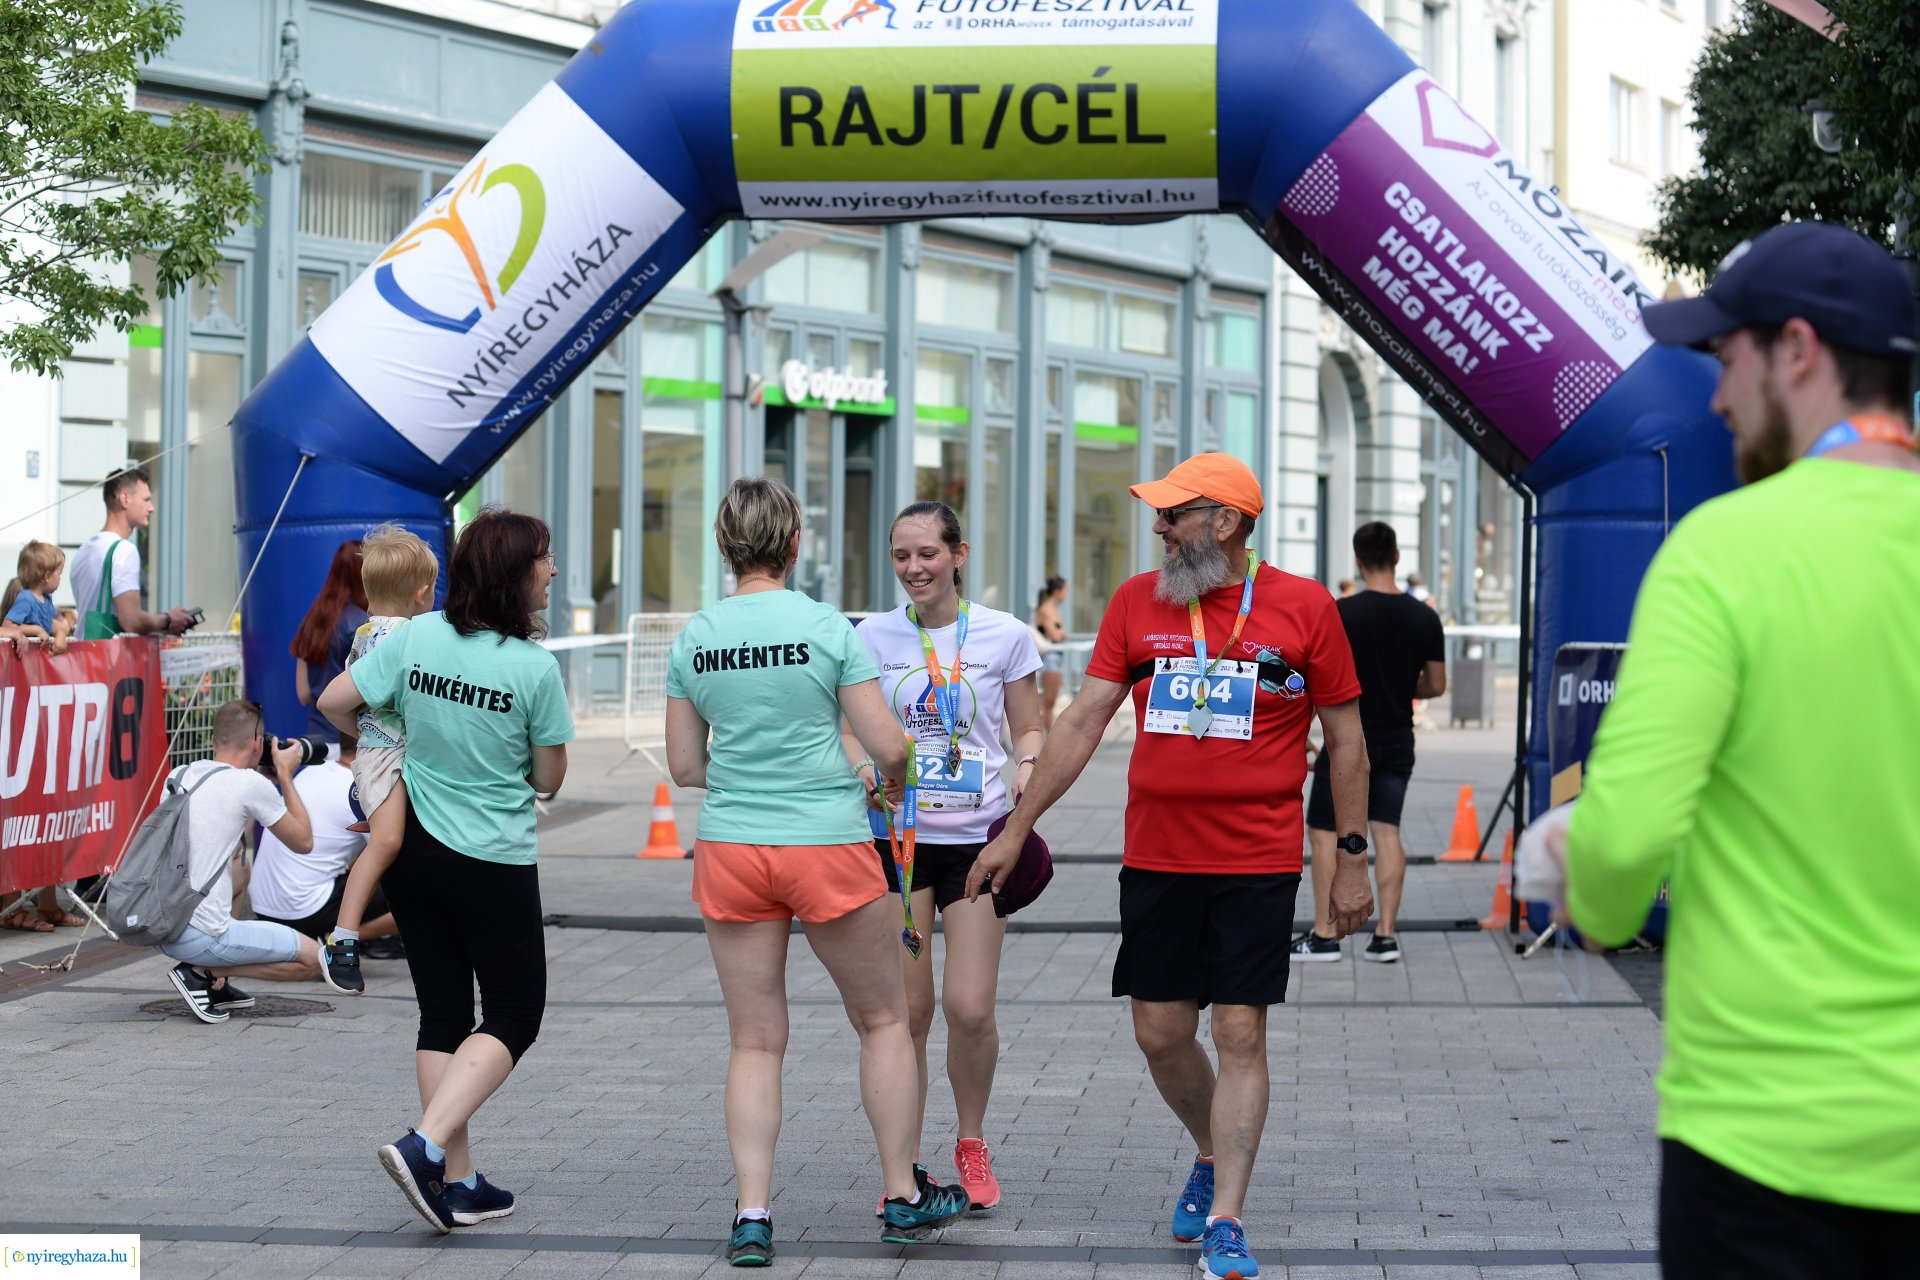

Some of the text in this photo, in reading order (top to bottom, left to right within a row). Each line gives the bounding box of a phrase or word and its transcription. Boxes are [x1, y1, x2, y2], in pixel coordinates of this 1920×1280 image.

[913, 20, 933, 29] az
[1062, 15, 1193, 31] támogatásával
[780, 66, 1167, 150] RAJT/CÉL
[759, 188, 1196, 211] www.nyiregyhazifutofesztival.hu
[1377, 225, 1510, 360] HOZZÁNK
[1384, 181, 1554, 353] CSATLAKOZZ
[1466, 179, 1628, 341] Az orvosi futóközösség
[446, 222, 632, 408] NYÍREGYHÁZA
[490, 262, 659, 434] www.nyiregyhaza.hu
[1302, 251, 1487, 437] www.mozaikmed.hu
[1362, 255, 1480, 375] MÉG MA!
[408, 664, 514, 714] ÖNKÉNTES
[693, 641, 810, 674] ÖNKÉNTES
[1169, 675, 1233, 703] 604
[1579, 679, 1618, 703] ORH
